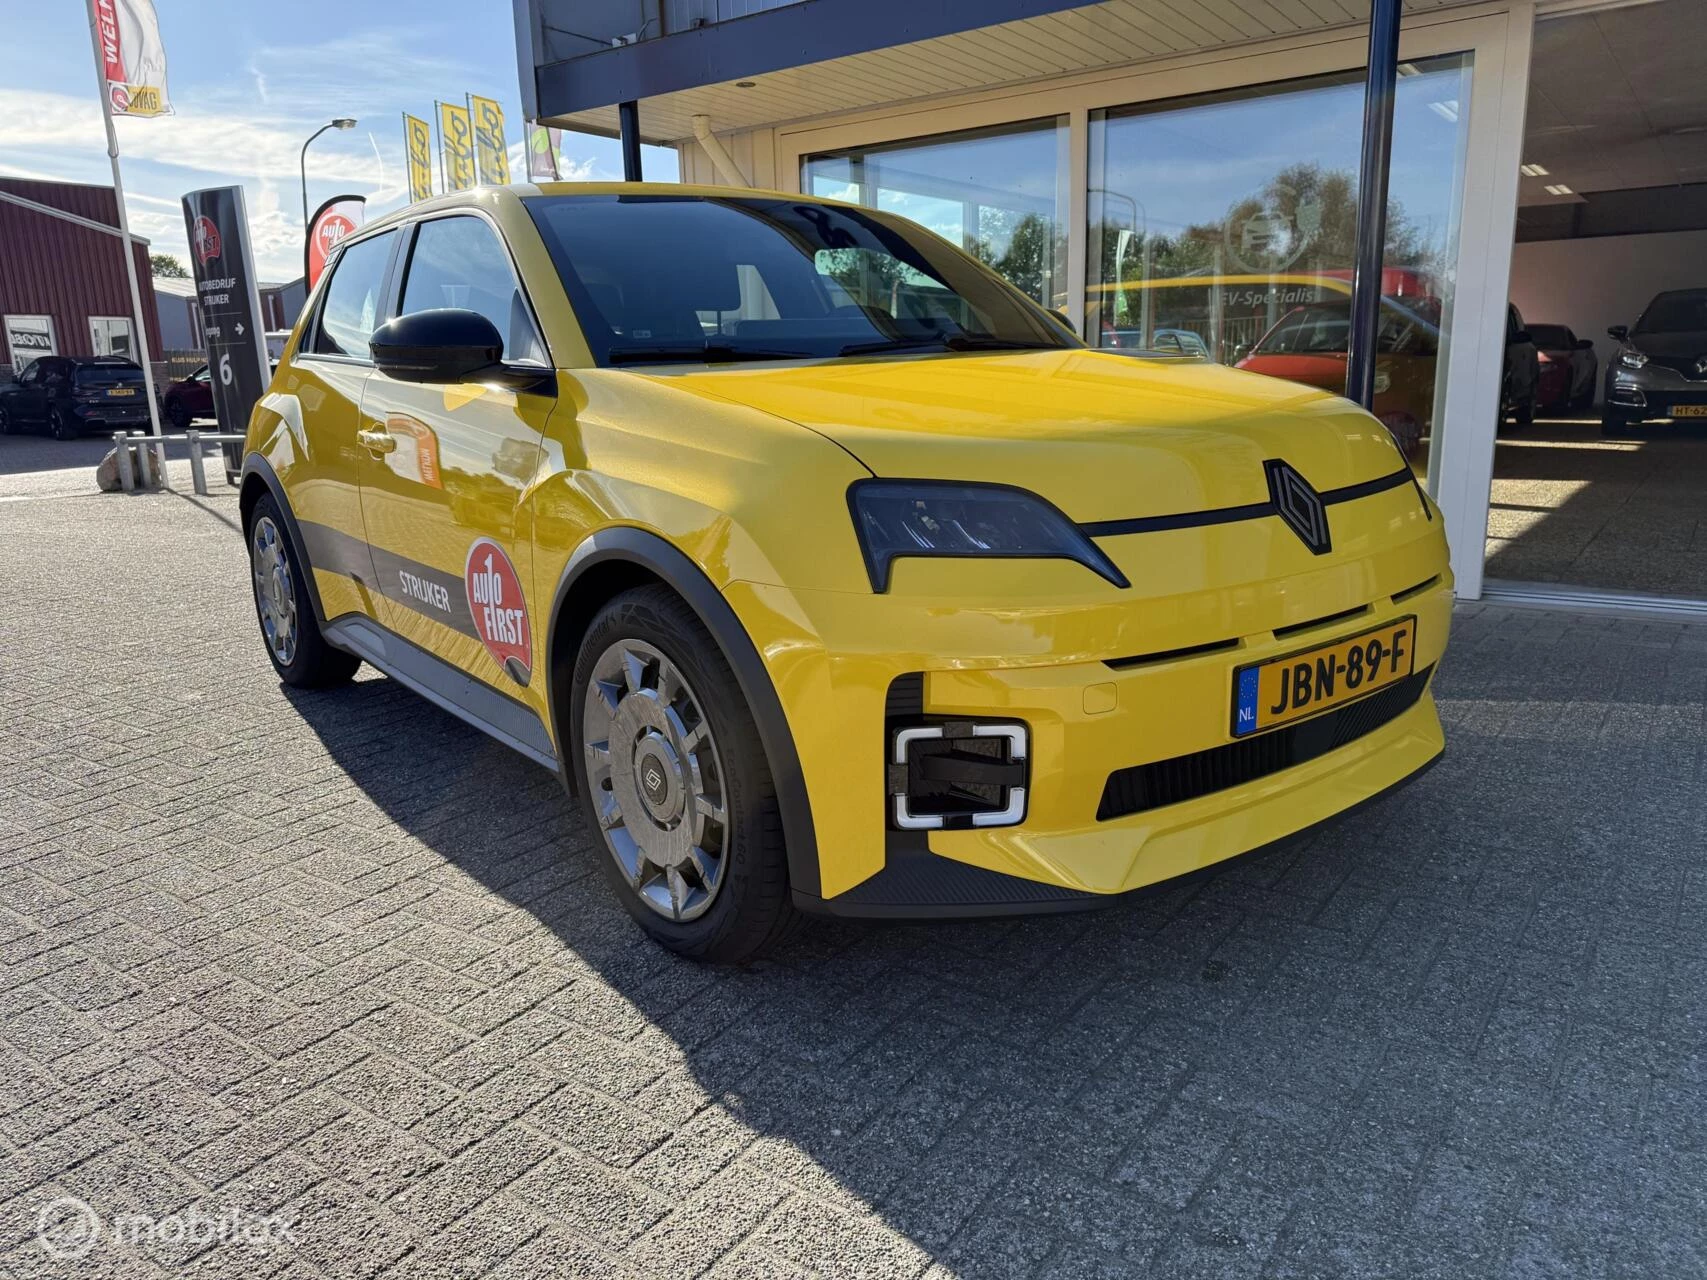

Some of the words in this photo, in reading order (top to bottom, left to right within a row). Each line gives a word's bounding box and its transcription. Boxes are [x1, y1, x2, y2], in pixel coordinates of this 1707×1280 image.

[1221, 287, 1320, 308] EV-Specialis
[219, 353, 232, 385] 6
[399, 570, 451, 613] STRIJKER
[483, 604, 524, 646] FIRST
[1270, 629, 1407, 715] JBN-89-F
[1239, 706, 1254, 723] NL
